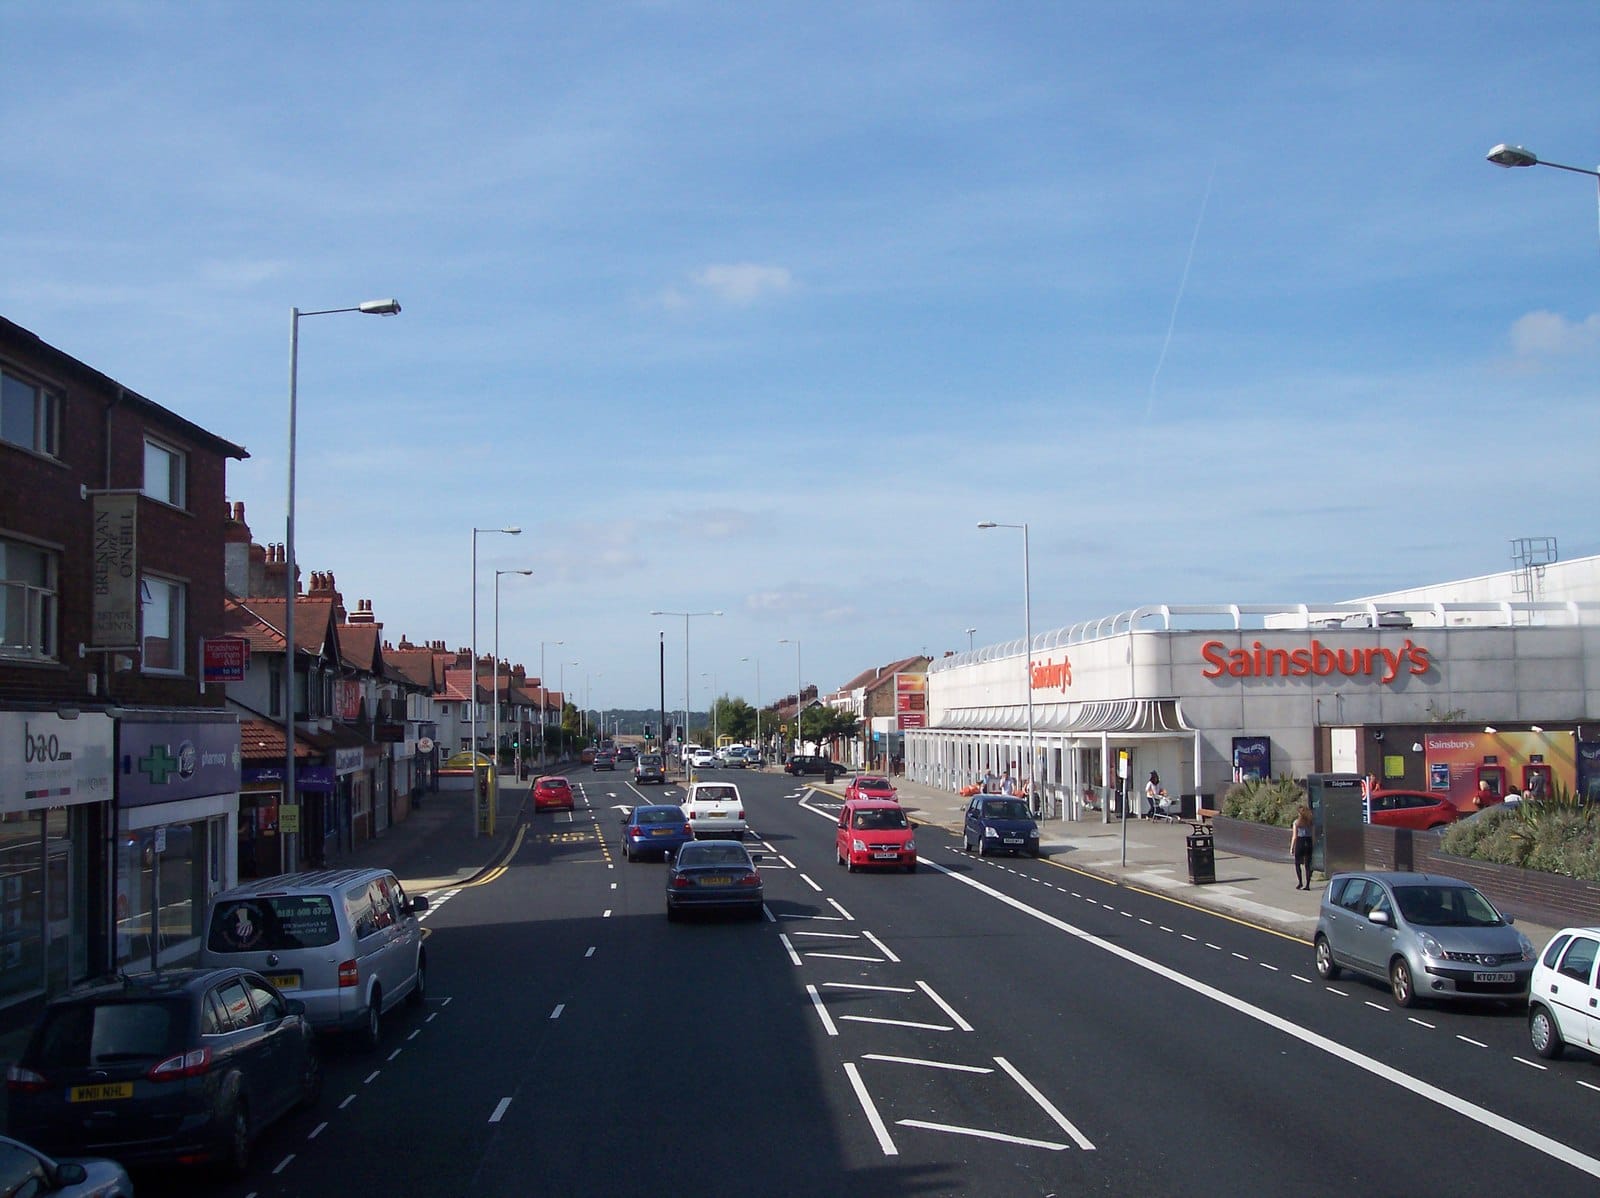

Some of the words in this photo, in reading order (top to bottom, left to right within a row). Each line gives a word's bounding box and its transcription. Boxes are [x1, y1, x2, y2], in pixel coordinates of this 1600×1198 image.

[95, 510, 109, 596] BRENNAN
[1030, 655, 1072, 694] Sainsbury's
[1201, 638, 1430, 684] Sainsbury's
[201, 750, 227, 768] pharmacy
[1428, 740, 1475, 750] Sainsbury's
